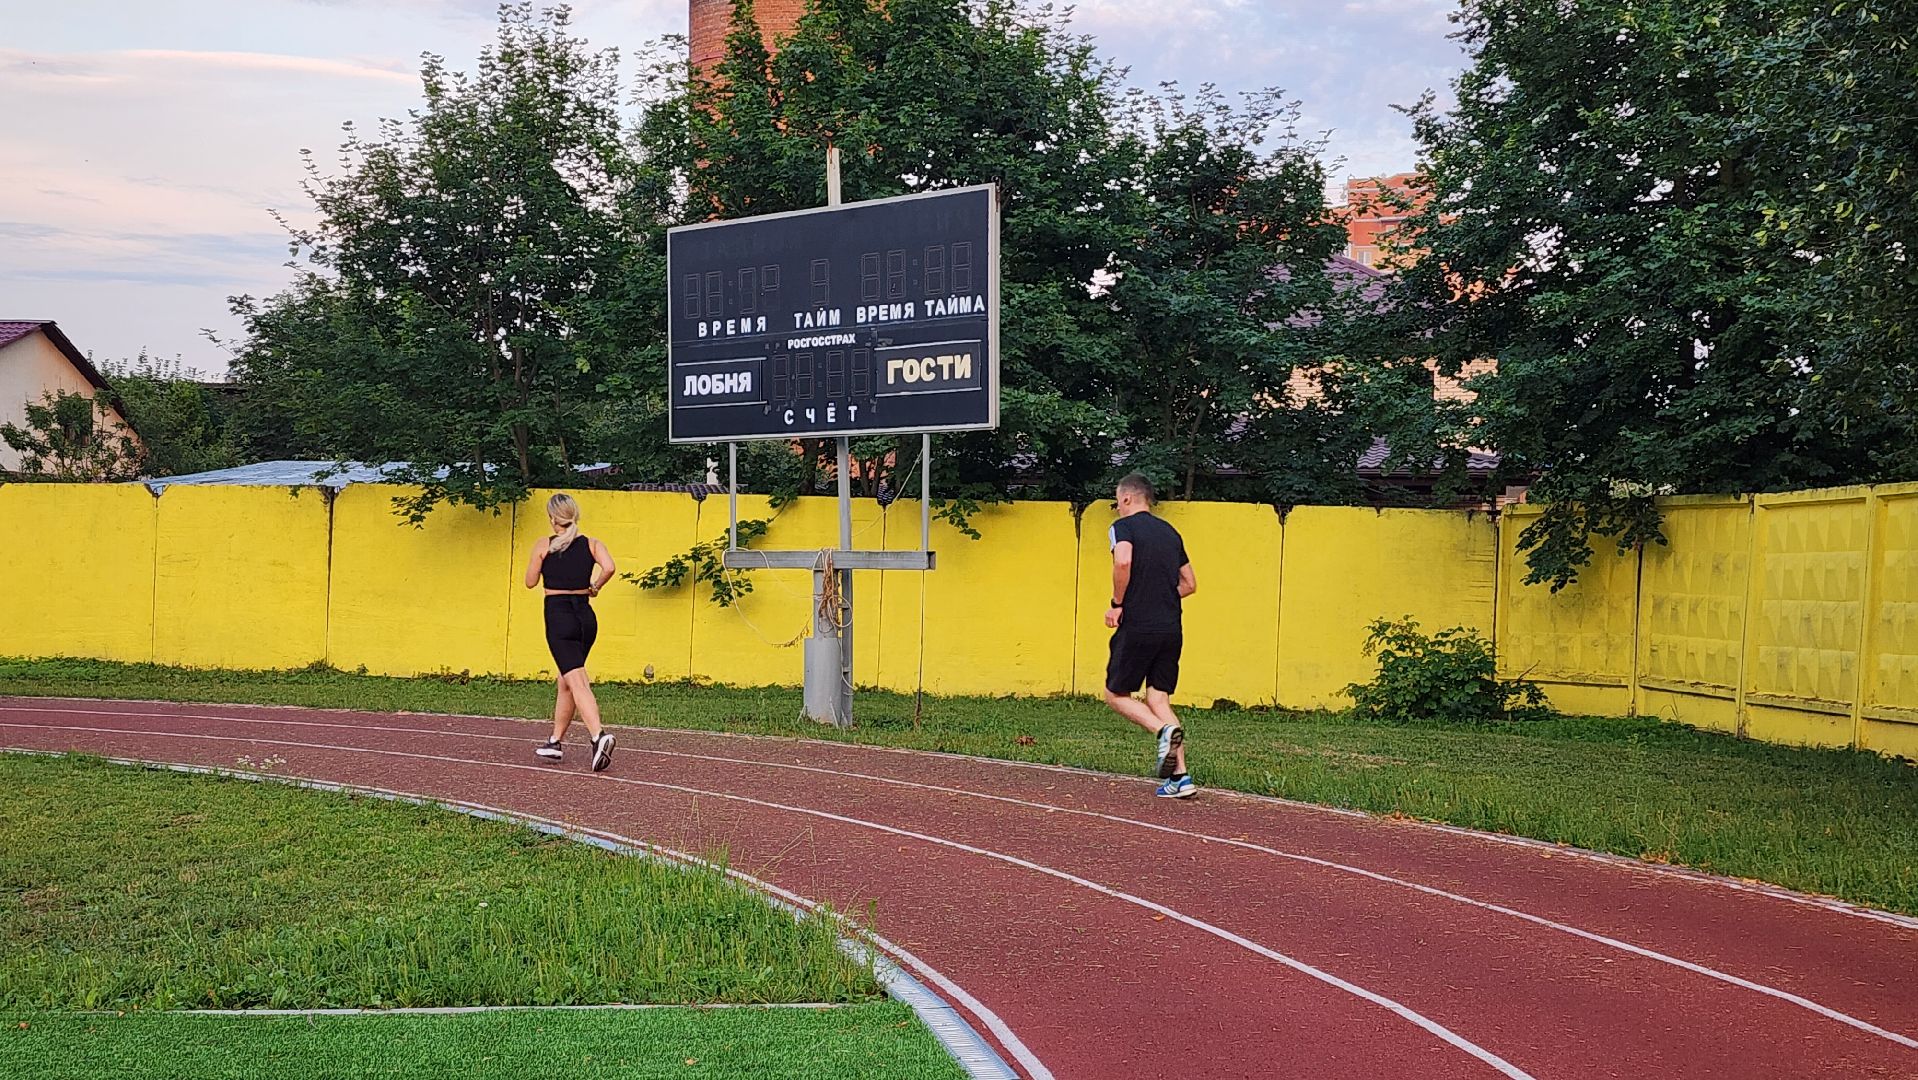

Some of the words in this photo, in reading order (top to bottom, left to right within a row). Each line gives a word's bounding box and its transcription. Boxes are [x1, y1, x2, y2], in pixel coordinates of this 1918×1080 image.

[794, 304, 841, 329] ТАЙМ
[856, 302, 915, 323] ВРЕМЯ
[924, 294, 986, 317] ТАЙМА
[698, 316, 767, 338] ВРЕМЯ
[787, 333, 856, 350] РОСГОССТРАХ
[887, 354, 972, 385] ГОСТИ
[683, 372, 752, 396] ЛОБНЯ
